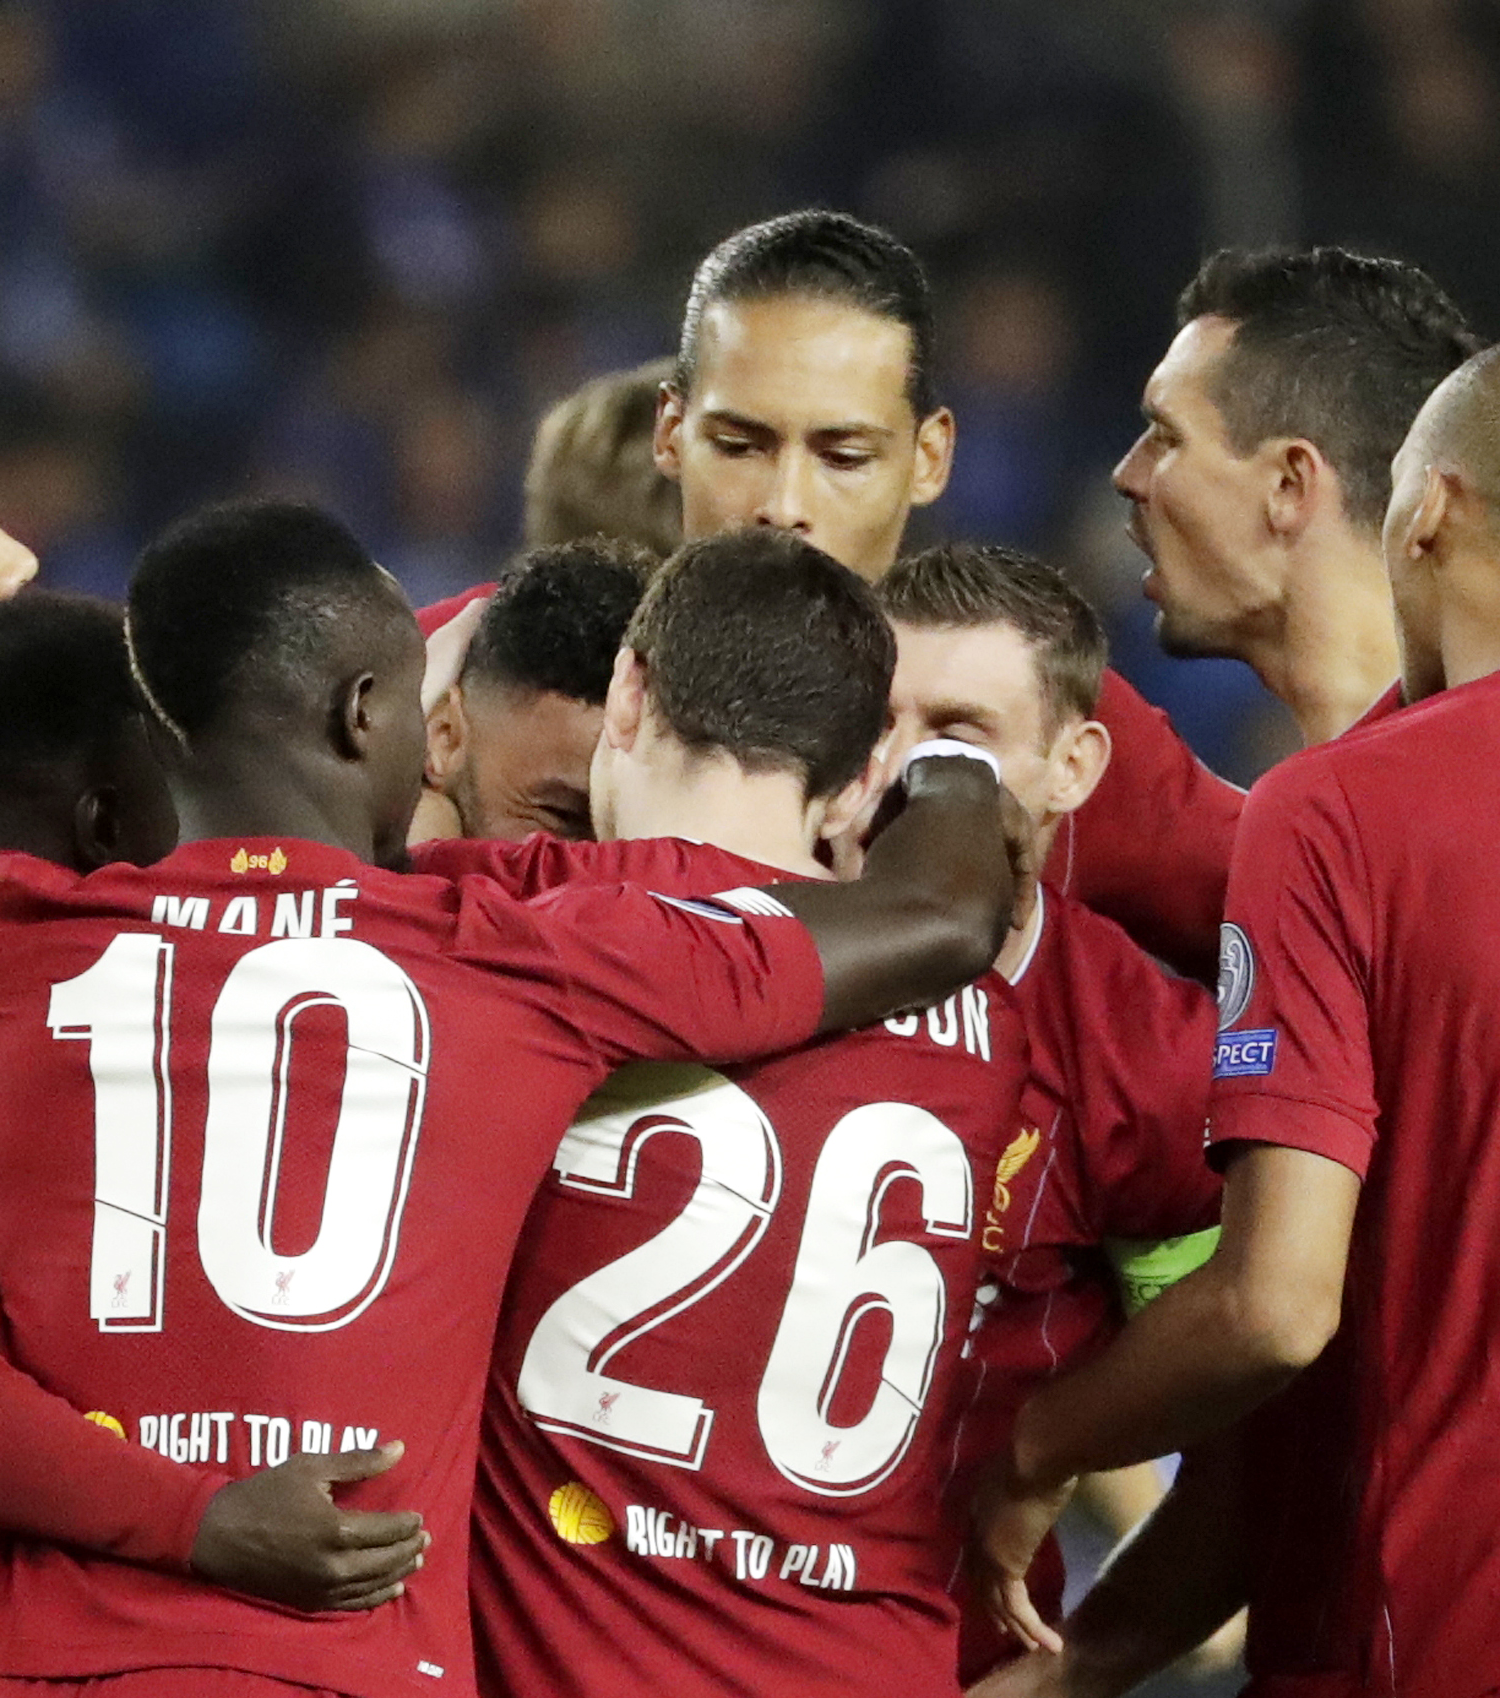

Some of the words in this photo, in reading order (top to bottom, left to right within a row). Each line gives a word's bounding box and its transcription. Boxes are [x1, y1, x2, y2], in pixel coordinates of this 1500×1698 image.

[151, 878, 360, 938] MANÉ
[1213, 1042, 1275, 1067] PECT
[47, 932, 430, 1333] 10
[517, 1061, 973, 1498] 26
[243, 1414, 290, 1468] TO
[626, 1505, 724, 1562] RIGHT
[731, 1530, 774, 1580] TO
[779, 1543, 856, 1591] PLAY
